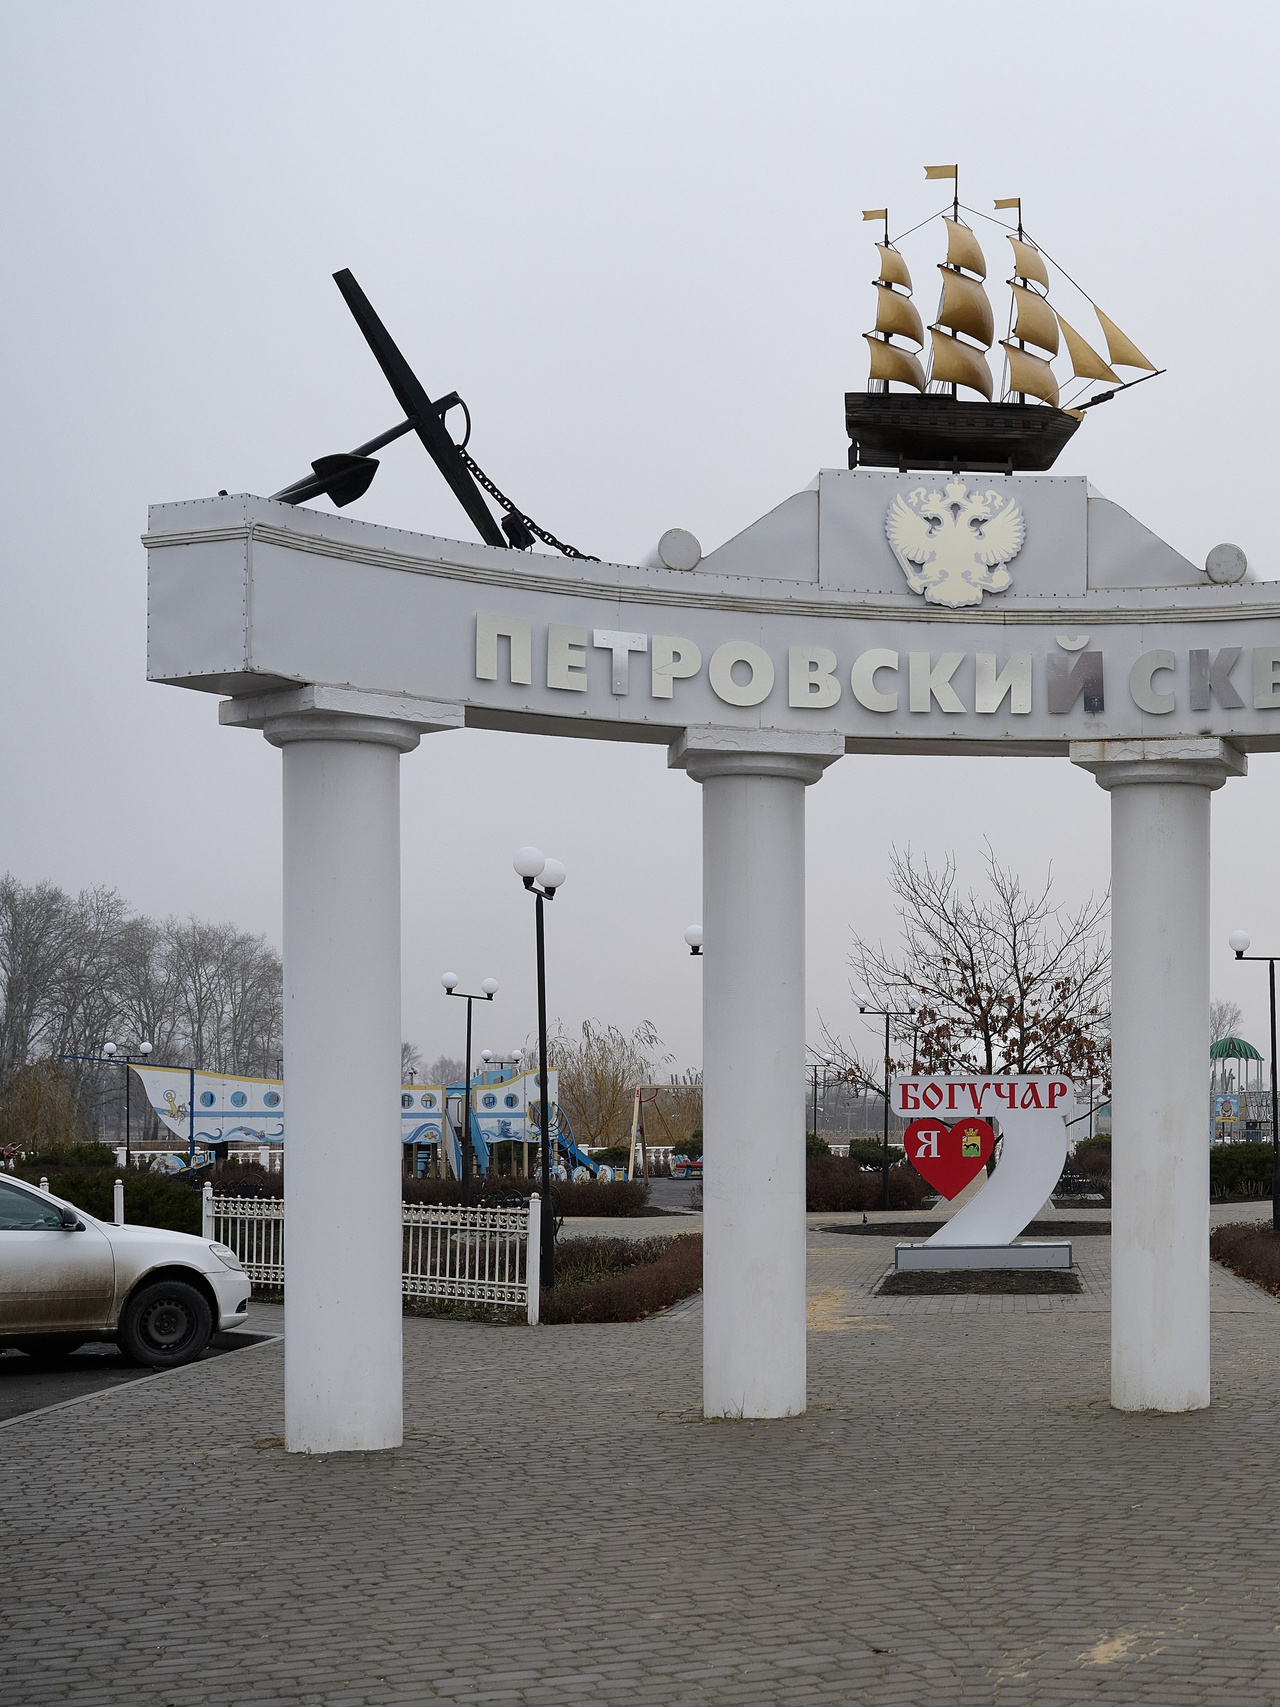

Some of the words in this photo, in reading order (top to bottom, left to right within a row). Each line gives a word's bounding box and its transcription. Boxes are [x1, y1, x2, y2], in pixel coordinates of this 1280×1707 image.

[475, 613, 1104, 714] ПЕТРОВСКИЙ
[899, 1082, 1068, 1115] БОГУЧАР
[915, 1130, 941, 1158] Я
